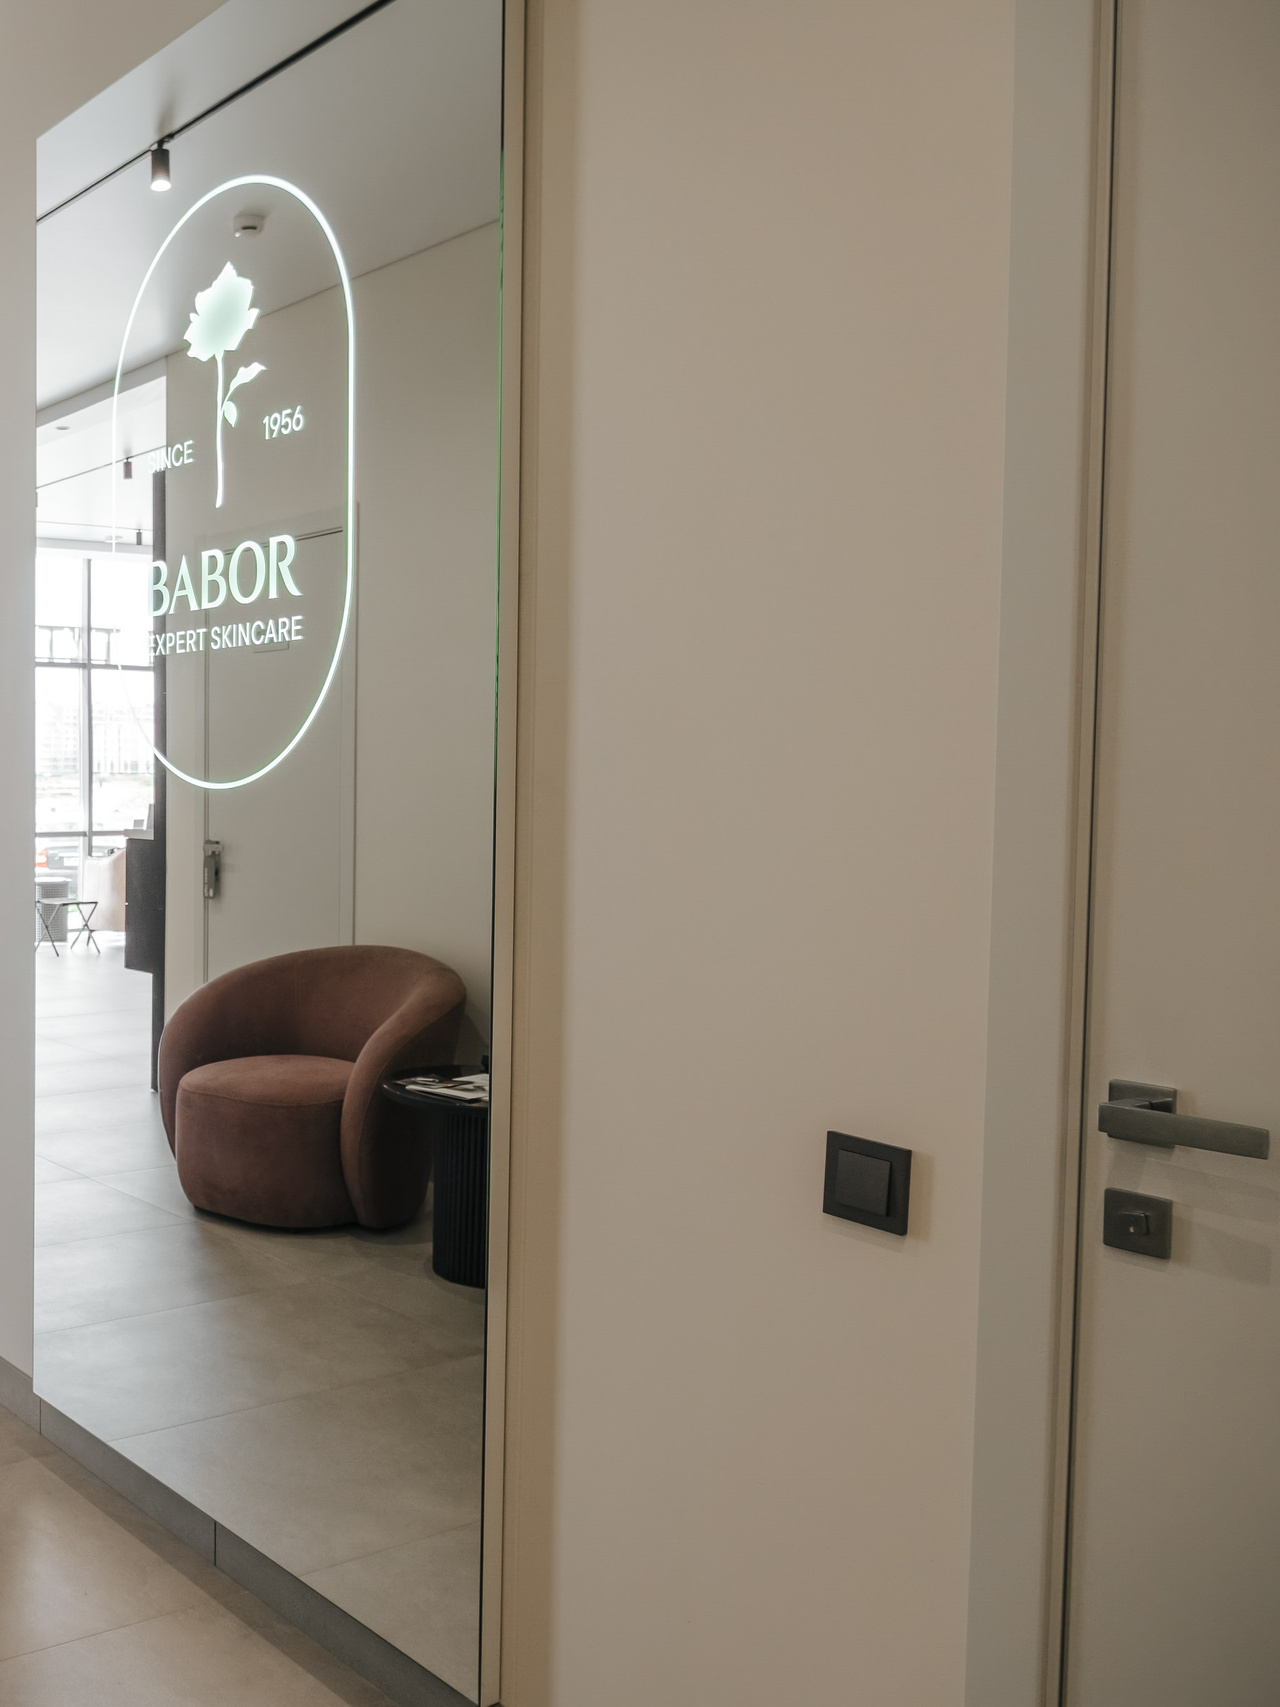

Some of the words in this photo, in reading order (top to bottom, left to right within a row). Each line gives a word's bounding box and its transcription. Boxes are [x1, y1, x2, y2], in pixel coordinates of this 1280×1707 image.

[148, 439, 194, 474] SINCE
[262, 405, 304, 440] 1956
[148, 534, 303, 617] BABOR
[148, 628, 207, 656] EXPERT
[210, 615, 303, 650] SKINCARE
